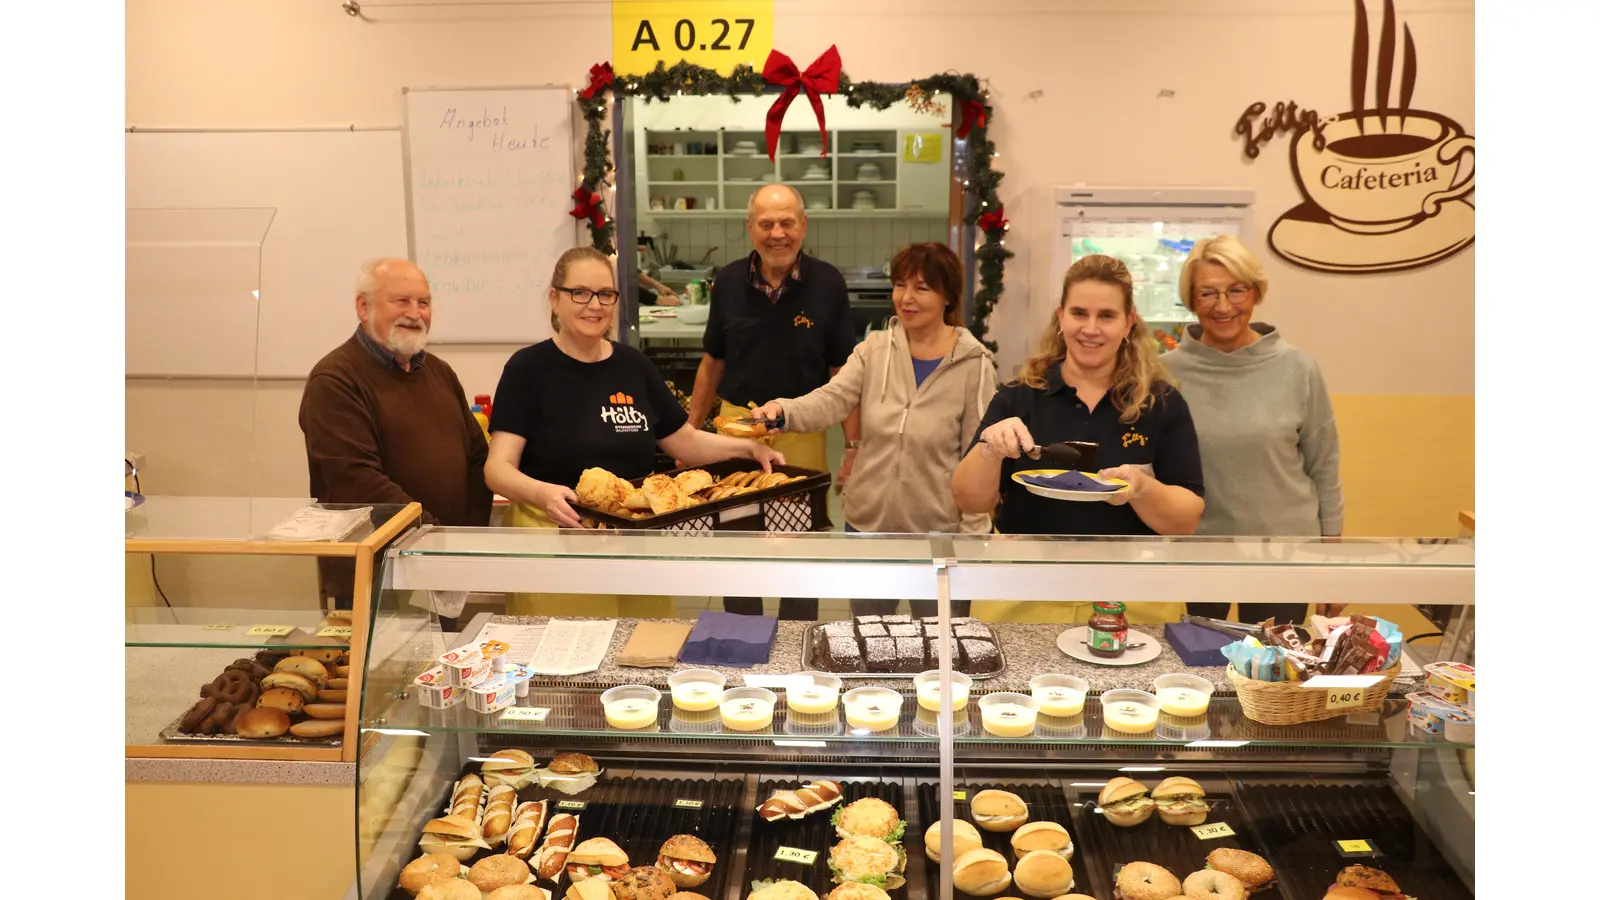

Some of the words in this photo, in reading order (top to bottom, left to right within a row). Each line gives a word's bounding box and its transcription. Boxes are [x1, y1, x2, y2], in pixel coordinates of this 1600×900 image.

[631, 19, 660, 51] A
[674, 18, 755, 51] 0.27
[440, 106, 509, 142] Angebot
[492, 123, 550, 151] Heute
[1320, 161, 1438, 190] Cafeteria
[600, 405, 650, 431] Hölty
[1330, 693, 1352, 704] 0,40
[1353, 692, 1361, 702] €
